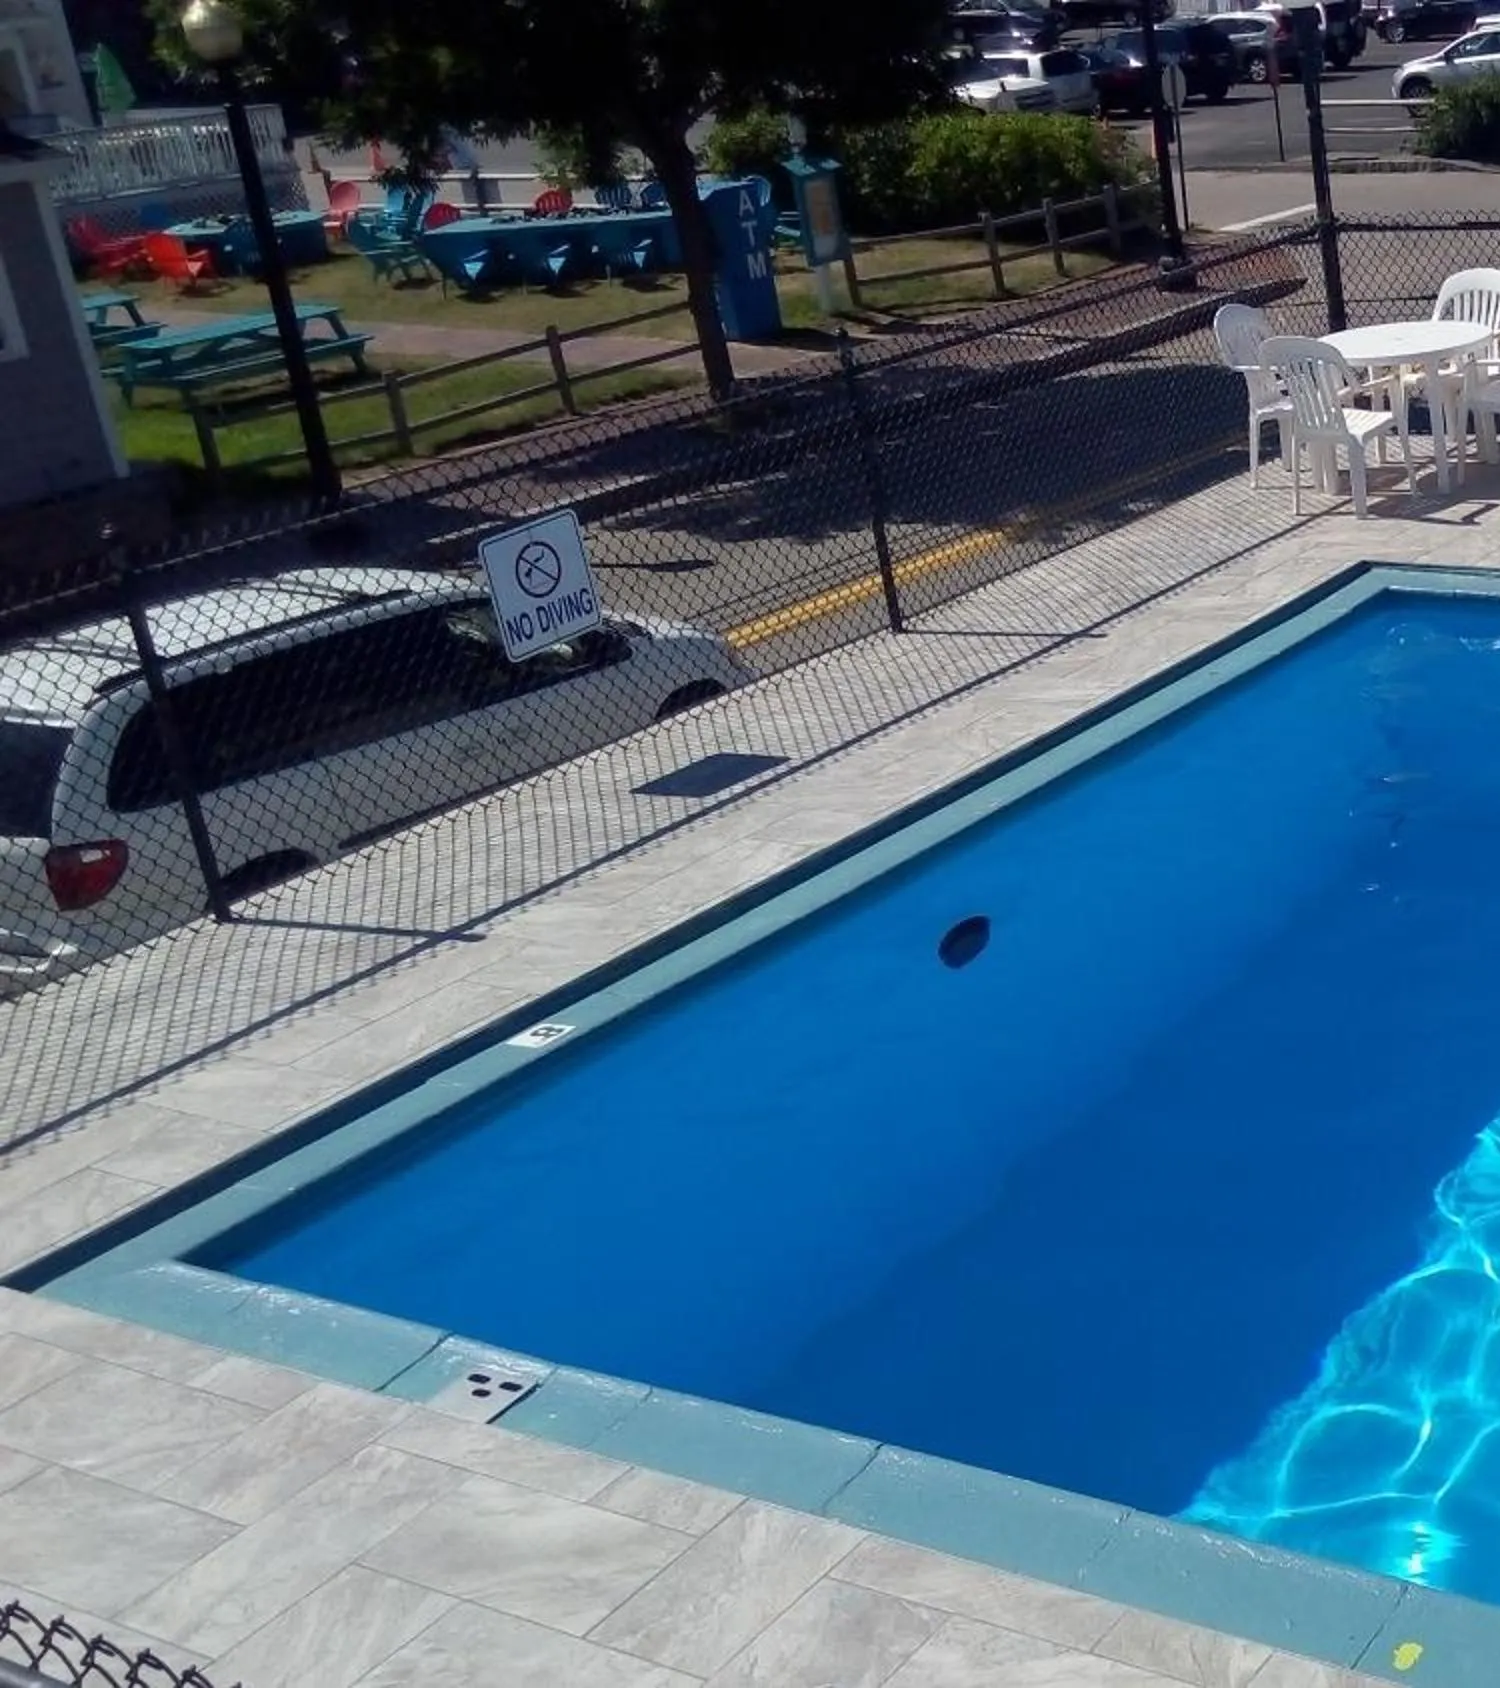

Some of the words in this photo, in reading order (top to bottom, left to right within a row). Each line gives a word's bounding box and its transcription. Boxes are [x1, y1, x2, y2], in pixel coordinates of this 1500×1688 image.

[738, 189, 767, 279] ATM
[505, 612, 534, 645] NO
[535, 588, 594, 632] DIVING
